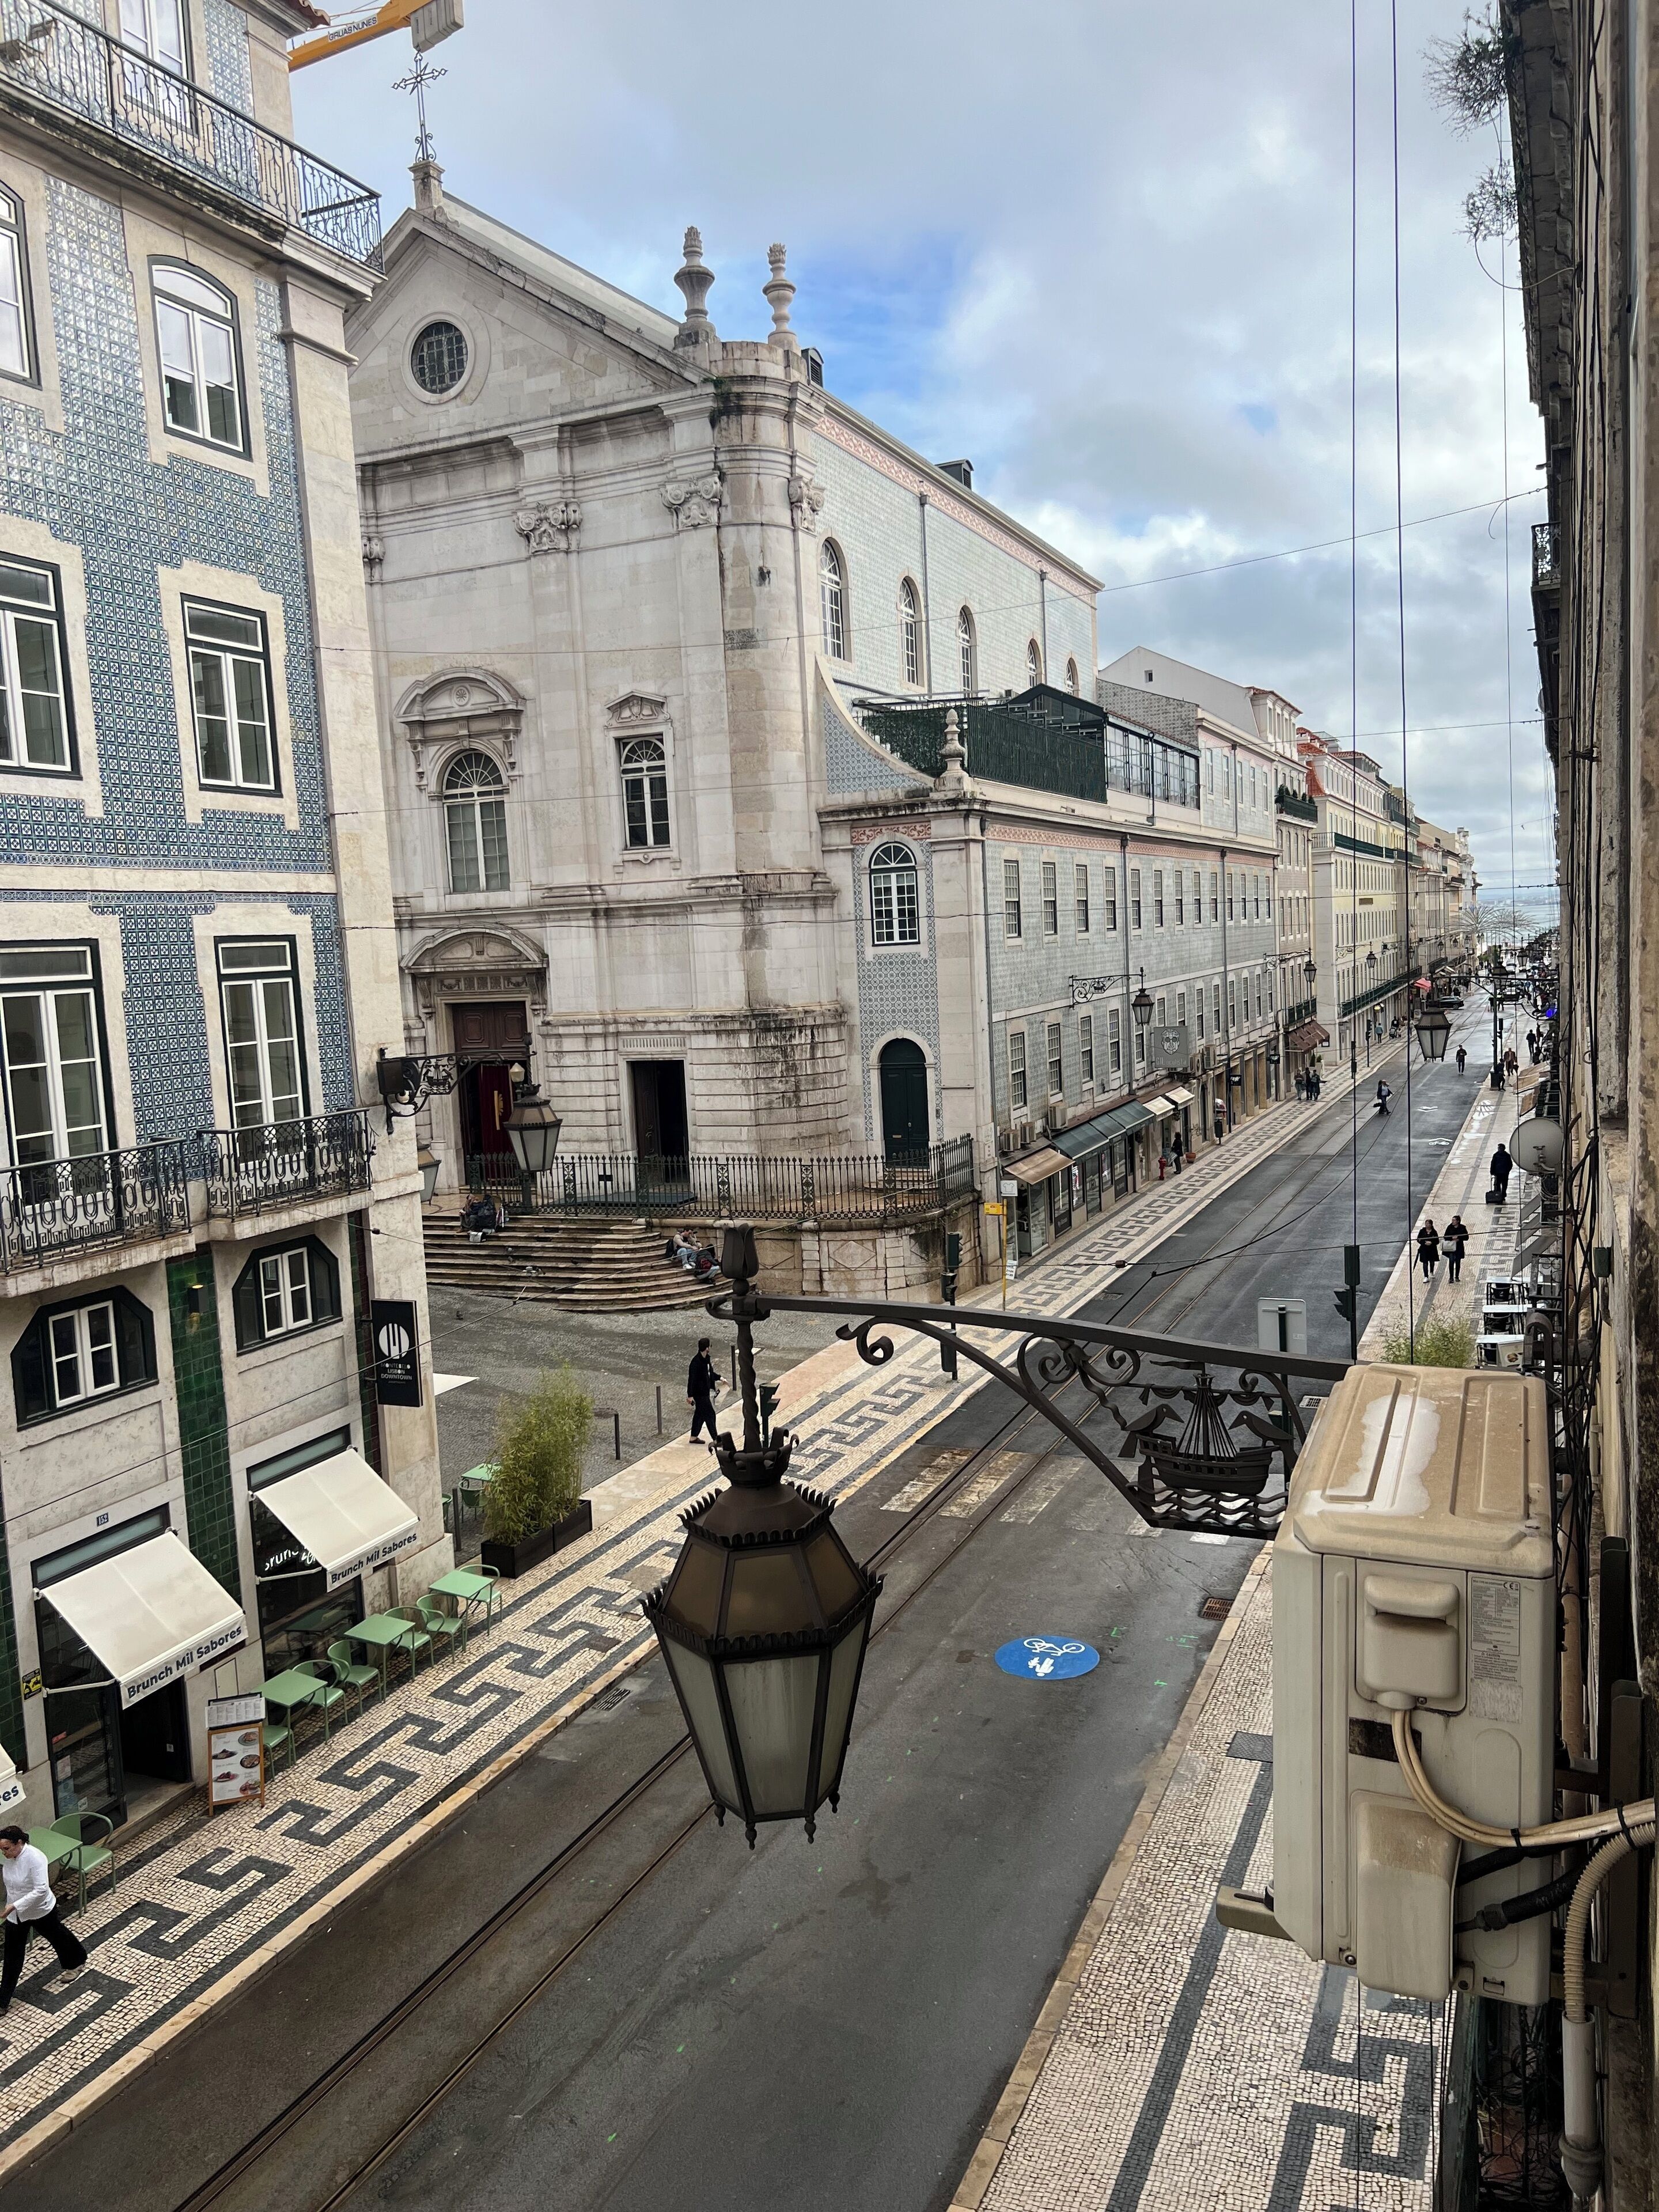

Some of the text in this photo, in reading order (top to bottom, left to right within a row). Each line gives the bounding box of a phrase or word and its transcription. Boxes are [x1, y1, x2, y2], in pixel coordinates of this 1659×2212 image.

[329, 16, 377, 41] GRUAS NUNES
[98, 1514, 108, 1525] 152
[331, 1533, 417, 1585] Brunch Mil Sabores
[127, 1626, 241, 1699] Brunch Mil Sabores
[0, 1785, 19, 1806] es
